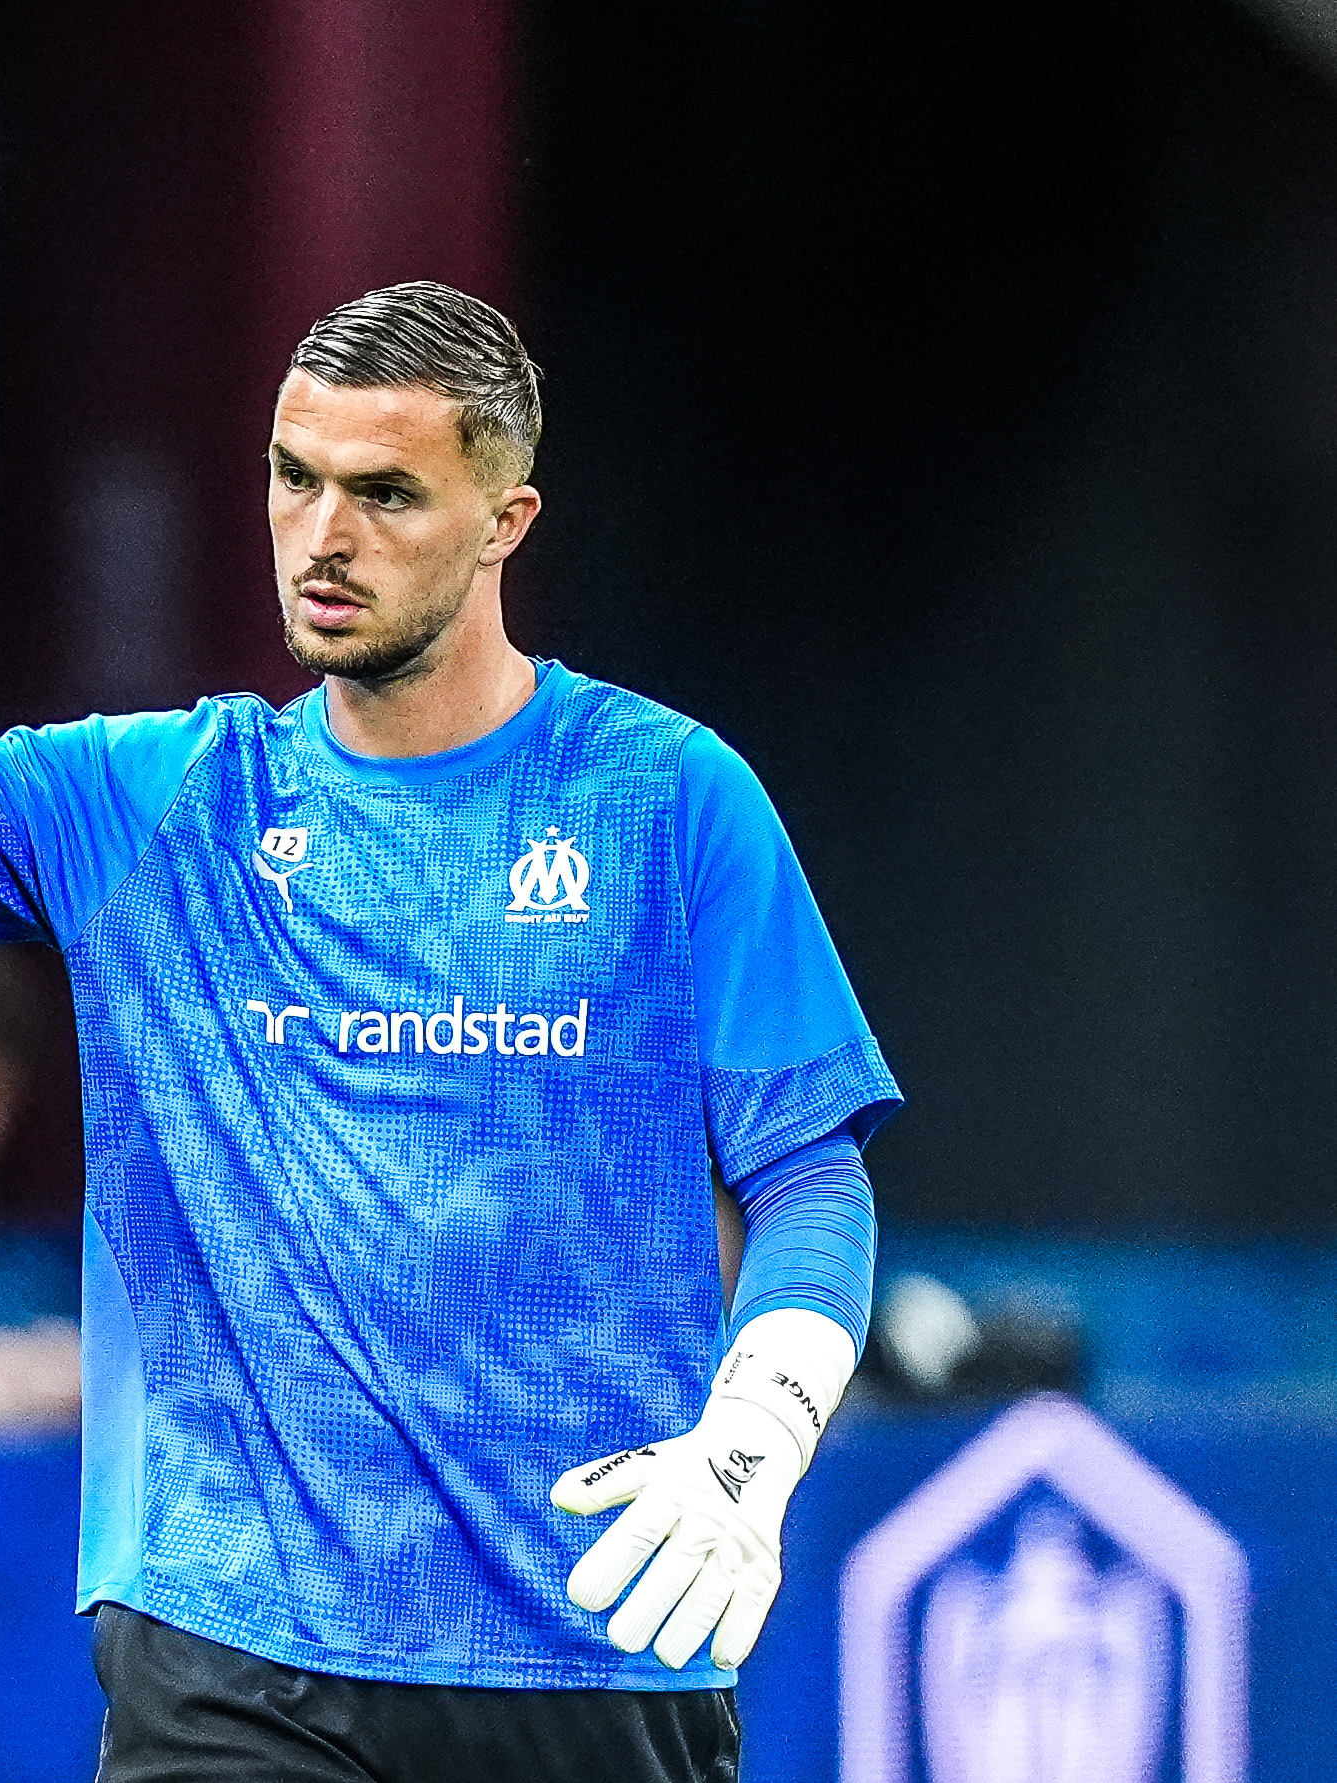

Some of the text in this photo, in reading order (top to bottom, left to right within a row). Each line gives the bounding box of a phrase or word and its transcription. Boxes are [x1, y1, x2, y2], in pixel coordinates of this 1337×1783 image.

[272, 836, 298, 856] 12
[338, 995, 589, 1057] randstad
[770, 1371, 821, 1435] ANGE
